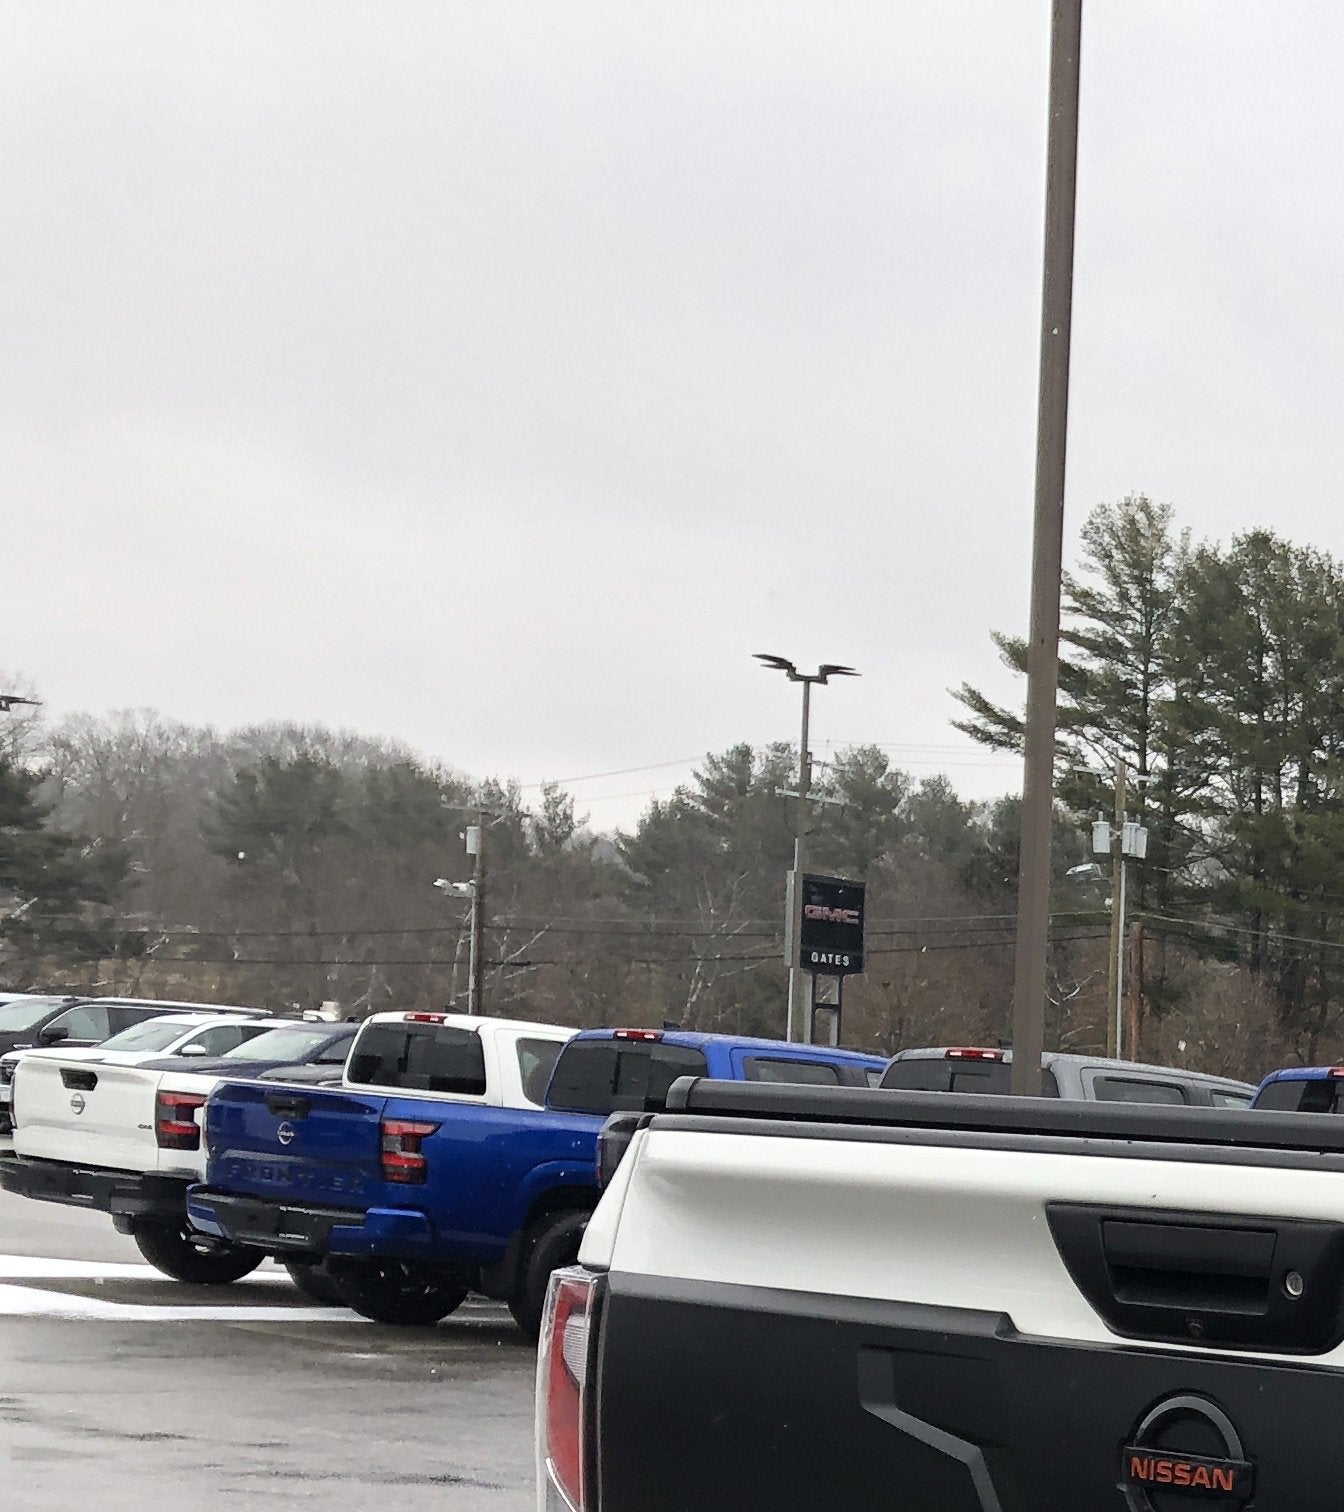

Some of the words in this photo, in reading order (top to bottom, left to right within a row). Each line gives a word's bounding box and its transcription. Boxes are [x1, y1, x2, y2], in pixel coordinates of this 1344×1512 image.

[804, 904, 858, 924] GMC
[811, 952, 850, 967] GATES
[1130, 1456, 1234, 1491] NISSAN
